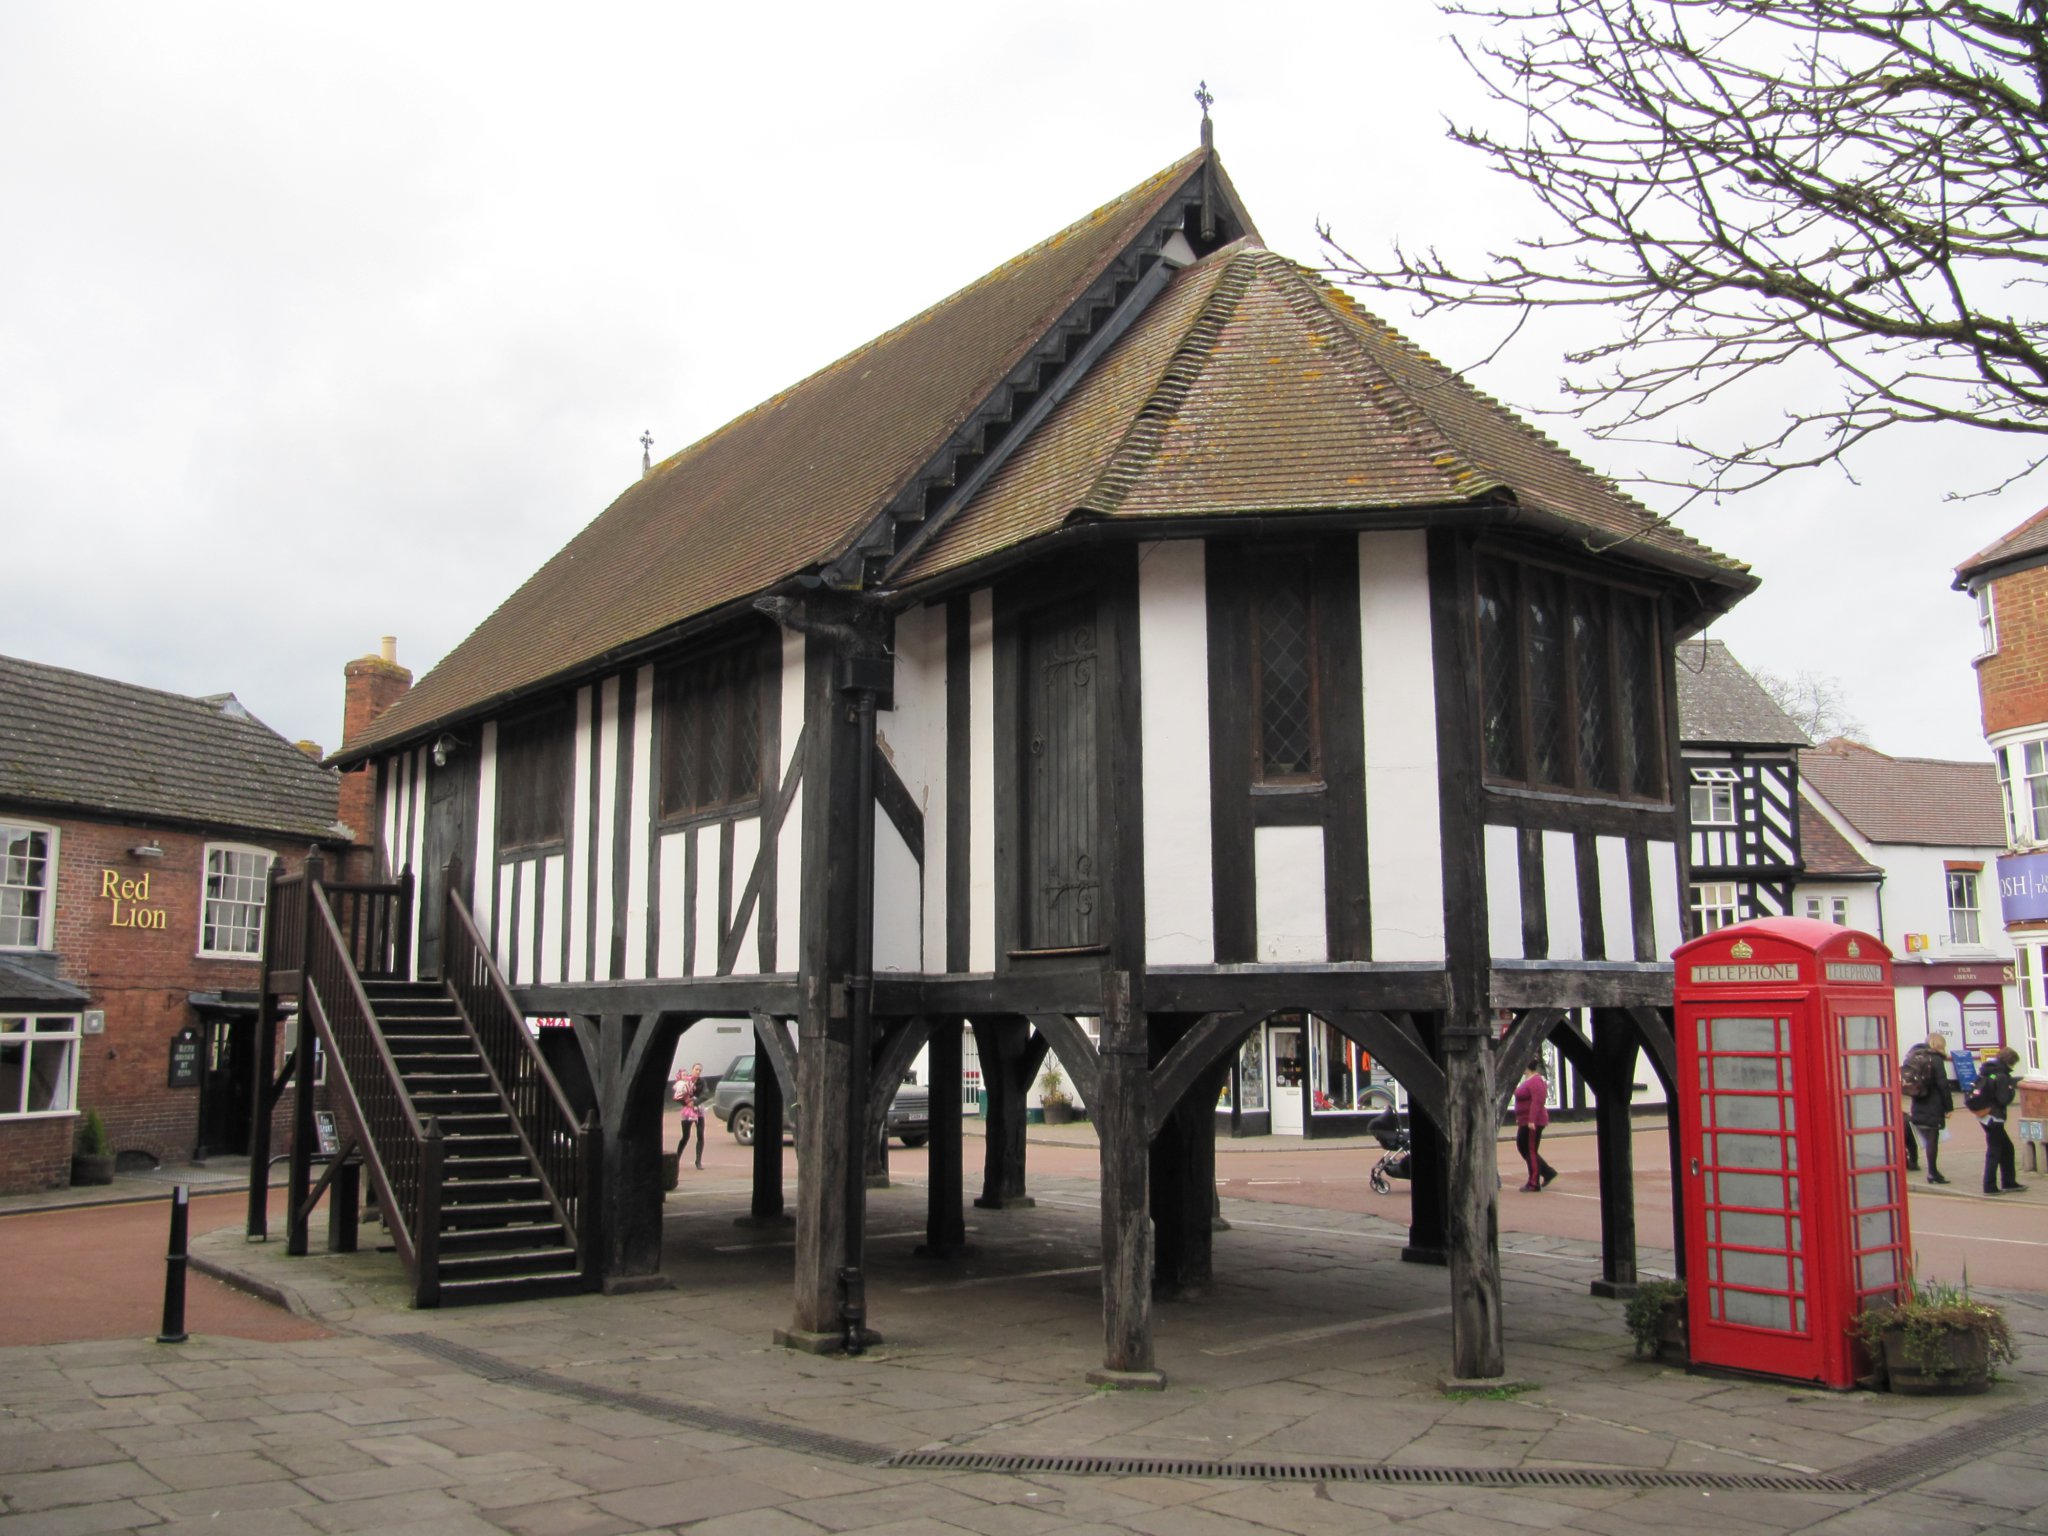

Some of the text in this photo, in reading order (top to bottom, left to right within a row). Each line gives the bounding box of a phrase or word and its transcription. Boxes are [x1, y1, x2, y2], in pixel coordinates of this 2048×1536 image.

[100, 869, 150, 900] Red
[109, 898, 167, 929] Lion
[1694, 964, 1795, 981] TELEPHONE
[1828, 963, 1881, 981] TELEPHONE
[1968, 1020, 1991, 1028] Greeting
